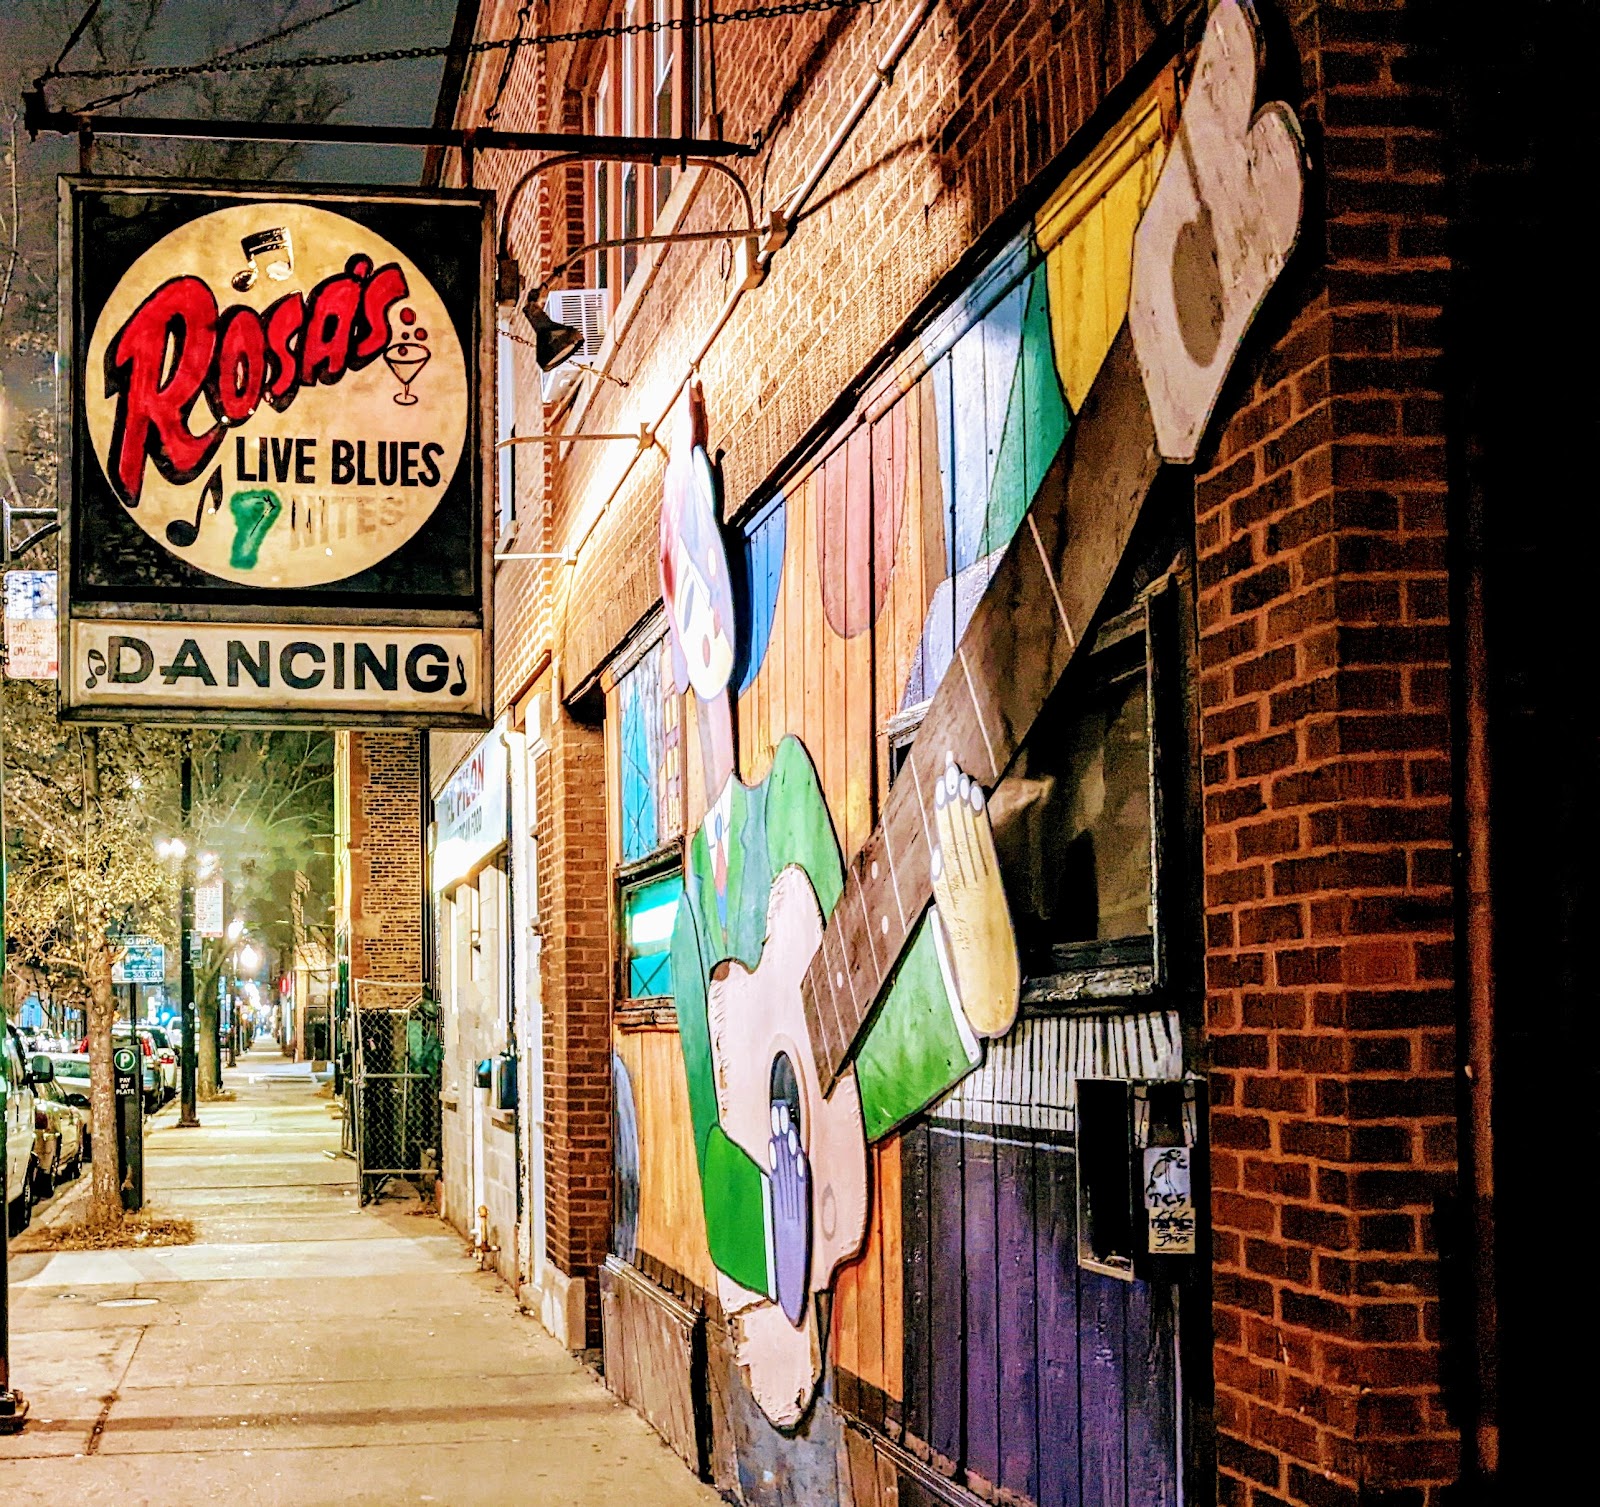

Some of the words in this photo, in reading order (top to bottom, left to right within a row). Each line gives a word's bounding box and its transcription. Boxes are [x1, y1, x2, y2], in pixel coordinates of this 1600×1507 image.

[236, 436, 316, 484] LIVE
[331, 439, 445, 487] BLUES
[229, 488, 283, 570] 7
[107, 636, 449, 693] DANCING
[120, 1053, 131, 1067] P
